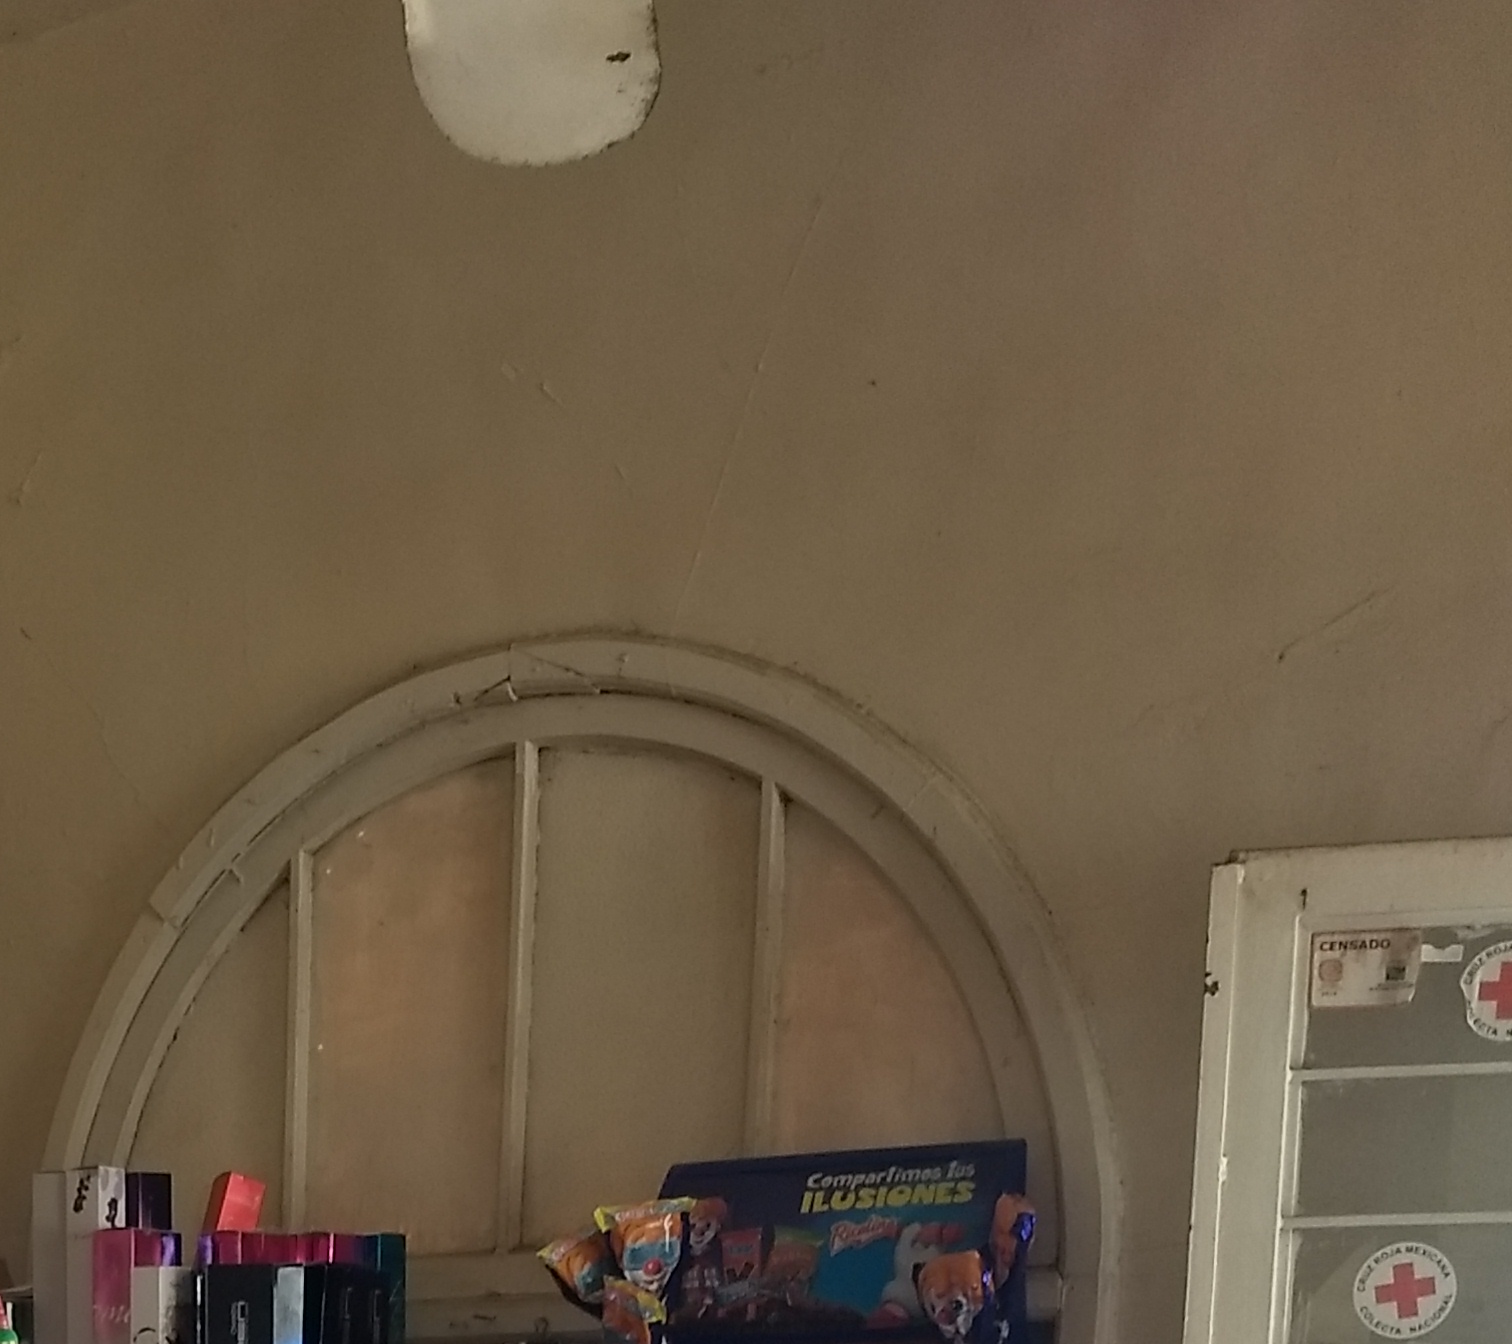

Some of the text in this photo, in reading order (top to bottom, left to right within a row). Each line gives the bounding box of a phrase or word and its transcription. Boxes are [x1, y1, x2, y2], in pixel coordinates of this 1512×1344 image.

[1319, 938, 1391, 952] CENSADO
[806, 1160, 976, 1190] Compartimos tus
[799, 1180, 977, 1214] ILUSIONES
